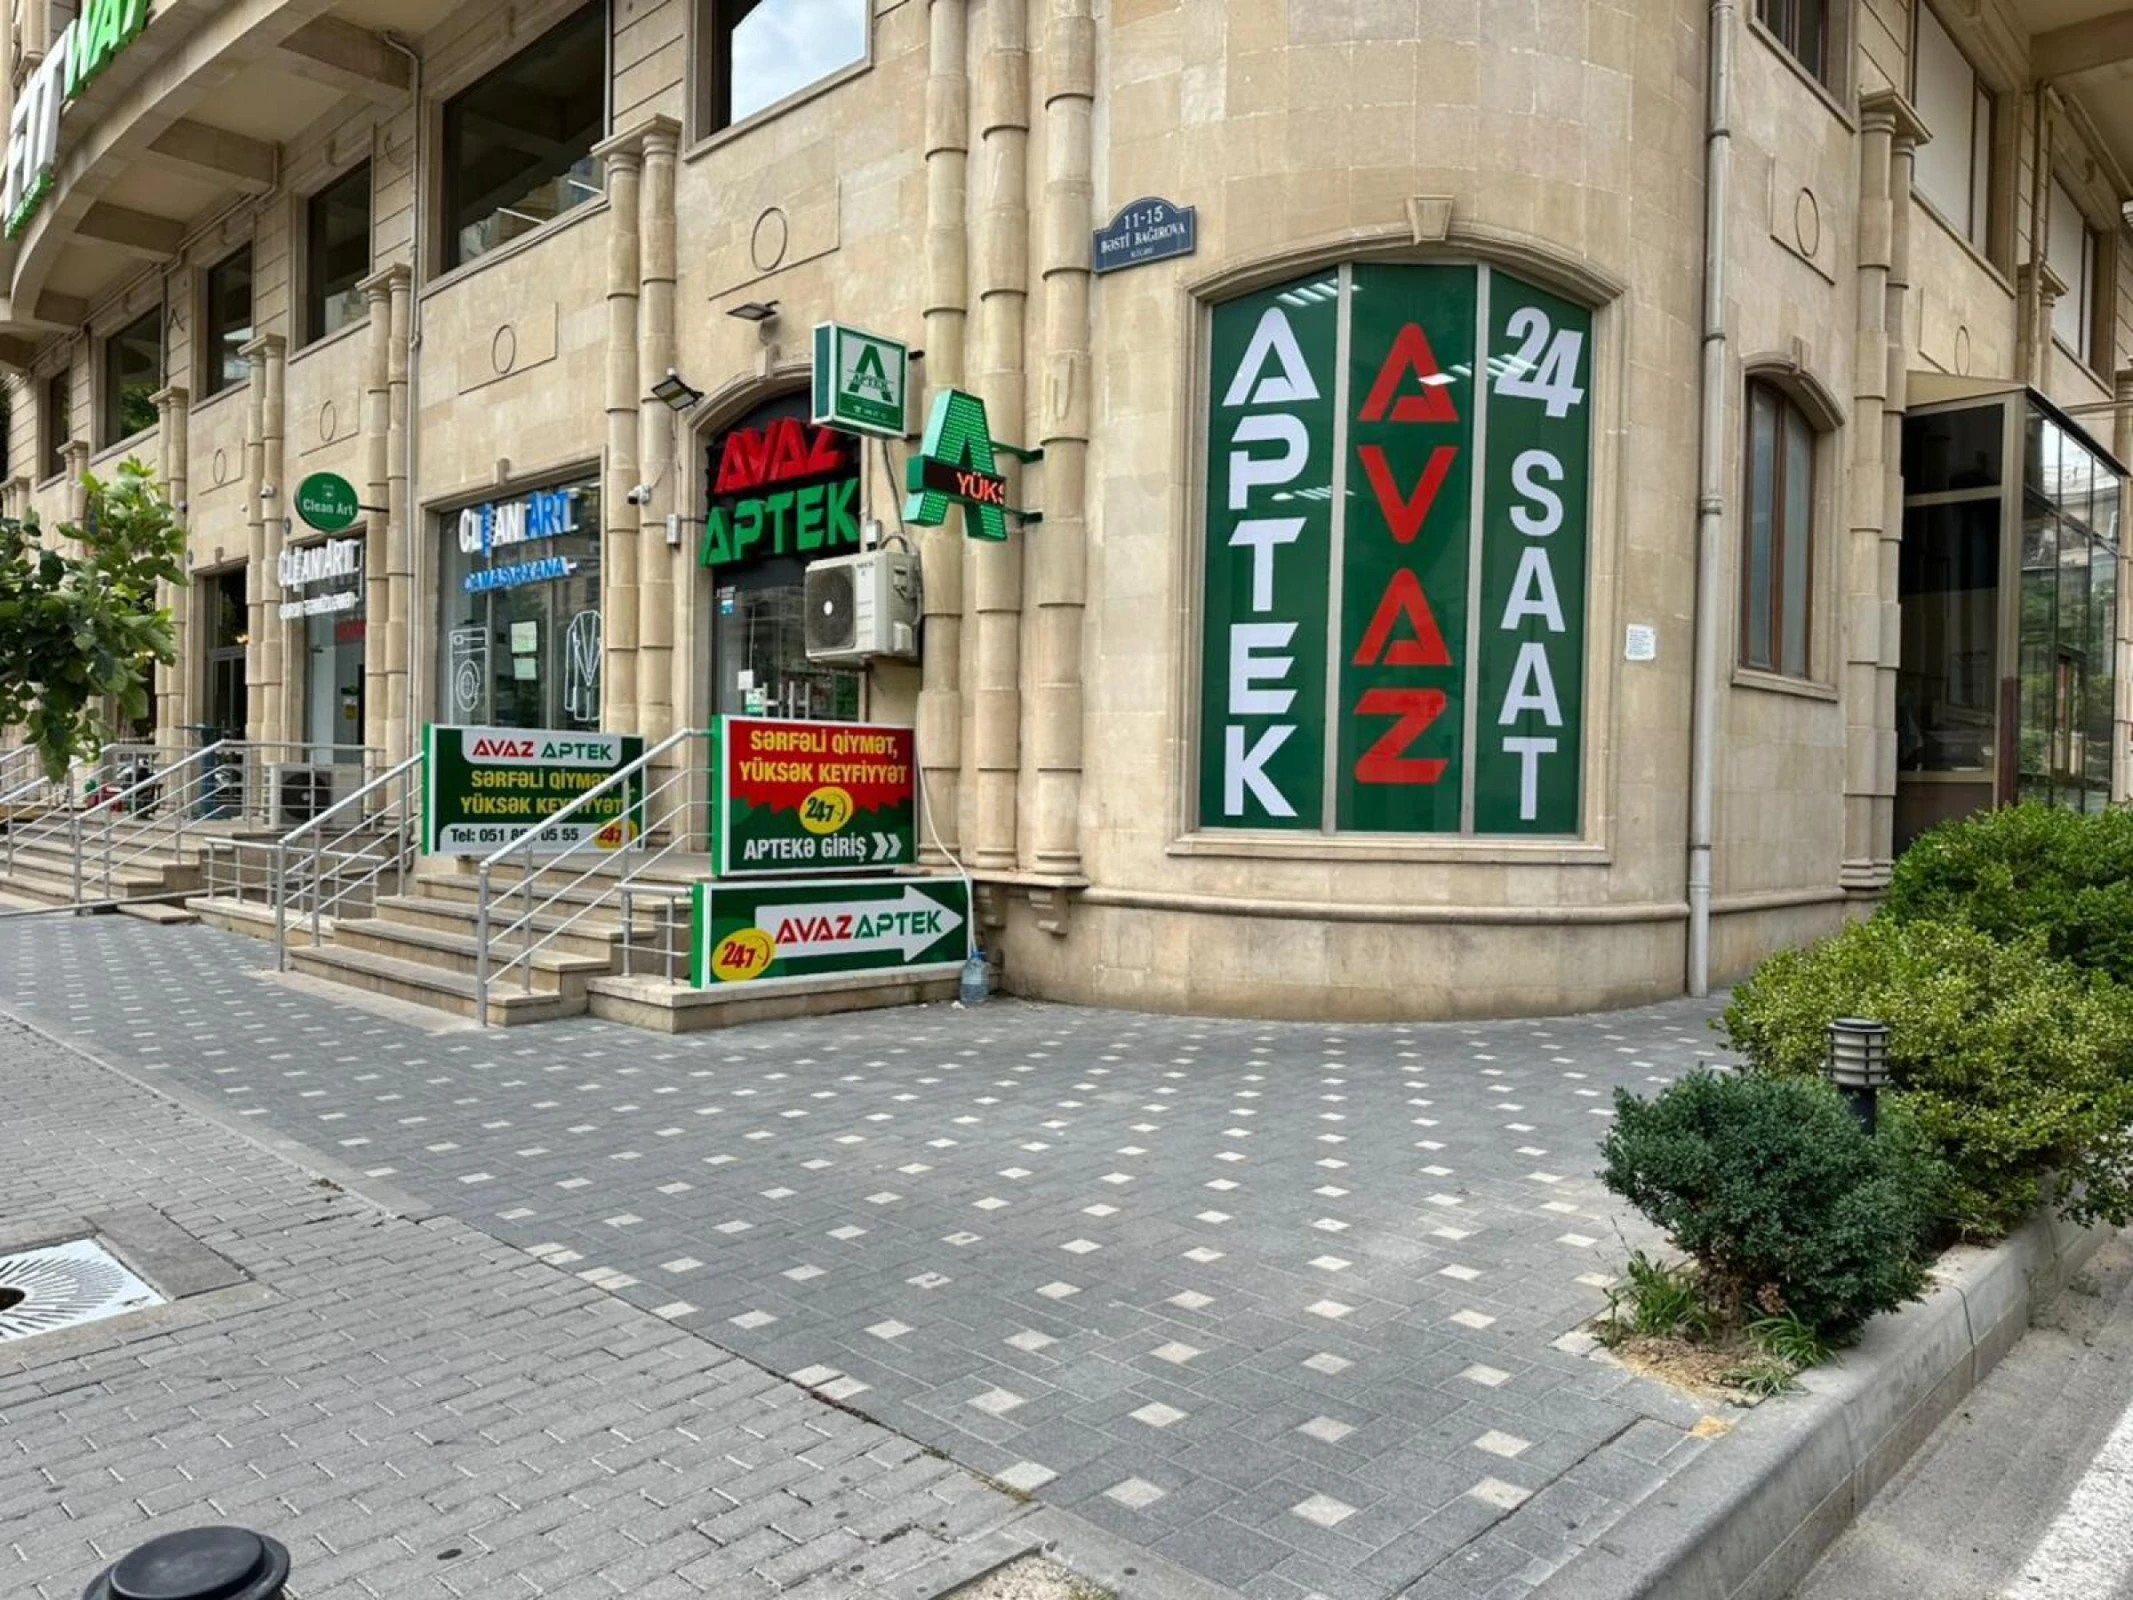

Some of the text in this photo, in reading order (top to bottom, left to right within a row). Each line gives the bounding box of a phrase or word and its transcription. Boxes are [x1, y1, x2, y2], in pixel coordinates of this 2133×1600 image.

[1123, 204, 1164, 230] 11-15
[714, 416, 841, 494] AVAZ
[303, 498, 353, 516] Clean Art
[459, 490, 572, 557] CLEAN ART
[698, 477, 861, 568] APTEK
[1222, 306, 1320, 817] APTEK
[1352, 322, 1460, 784] AVAZ
[1494, 306, 1584, 821] 24 SAAT
[472, 738, 613, 761] AVAZ APTEK
[751, 730, 899, 760] SƏRFƏLİ QİYMƏT,
[471, 768, 545, 788] SƏRFƏLİ
[739, 757, 907, 784] YÜKSƏK KEYFİYYƏT
[460, 793, 532, 814] YÜKSƏK
[451, 828, 475, 843] Tel:
[479, 828, 505, 842] 051
[562, 828, 579, 842] 55
[743, 832, 868, 863] APTEKƏ GİRİŞ
